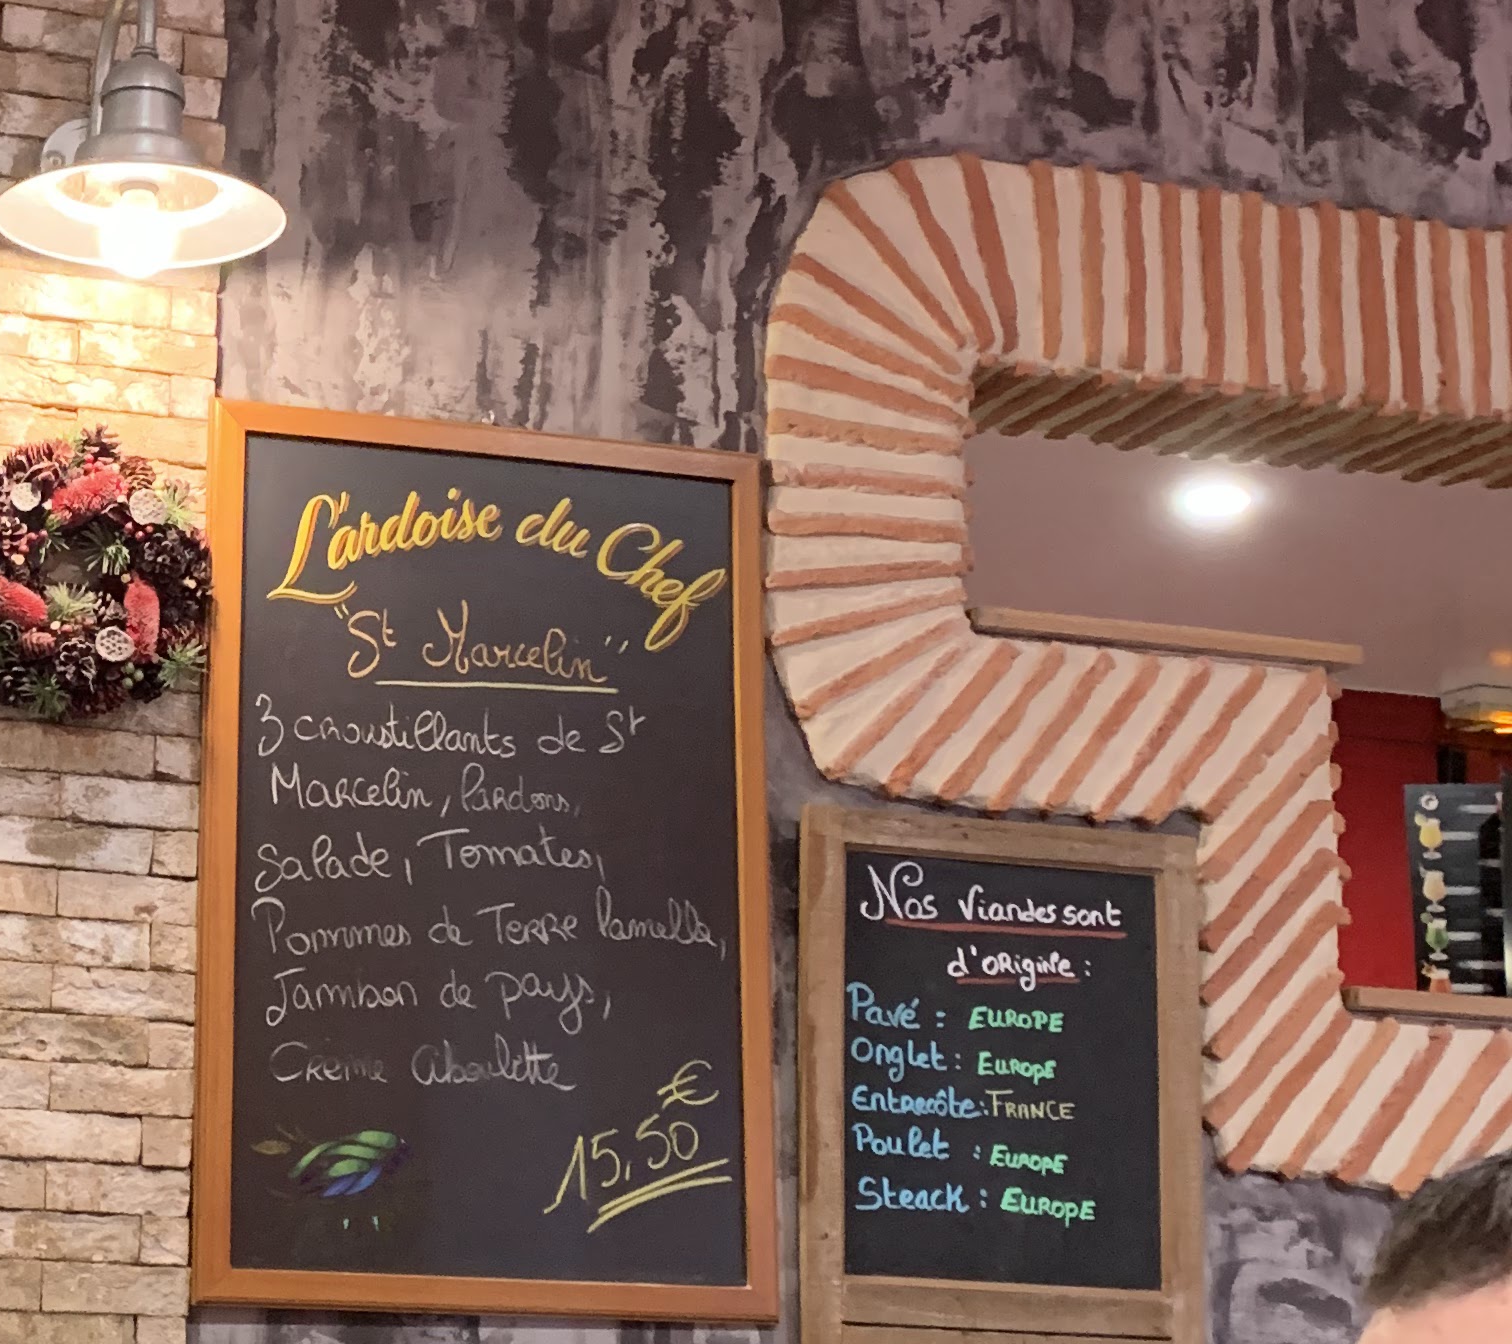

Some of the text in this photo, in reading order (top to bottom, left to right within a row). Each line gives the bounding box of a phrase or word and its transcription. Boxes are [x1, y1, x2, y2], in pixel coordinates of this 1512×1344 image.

[515, 496, 593, 560] du
[596, 522, 728, 653] Chef
[537, 718, 588, 755] de
[859, 861, 940, 922] Nos
[854, 1176, 971, 1213] Steack
